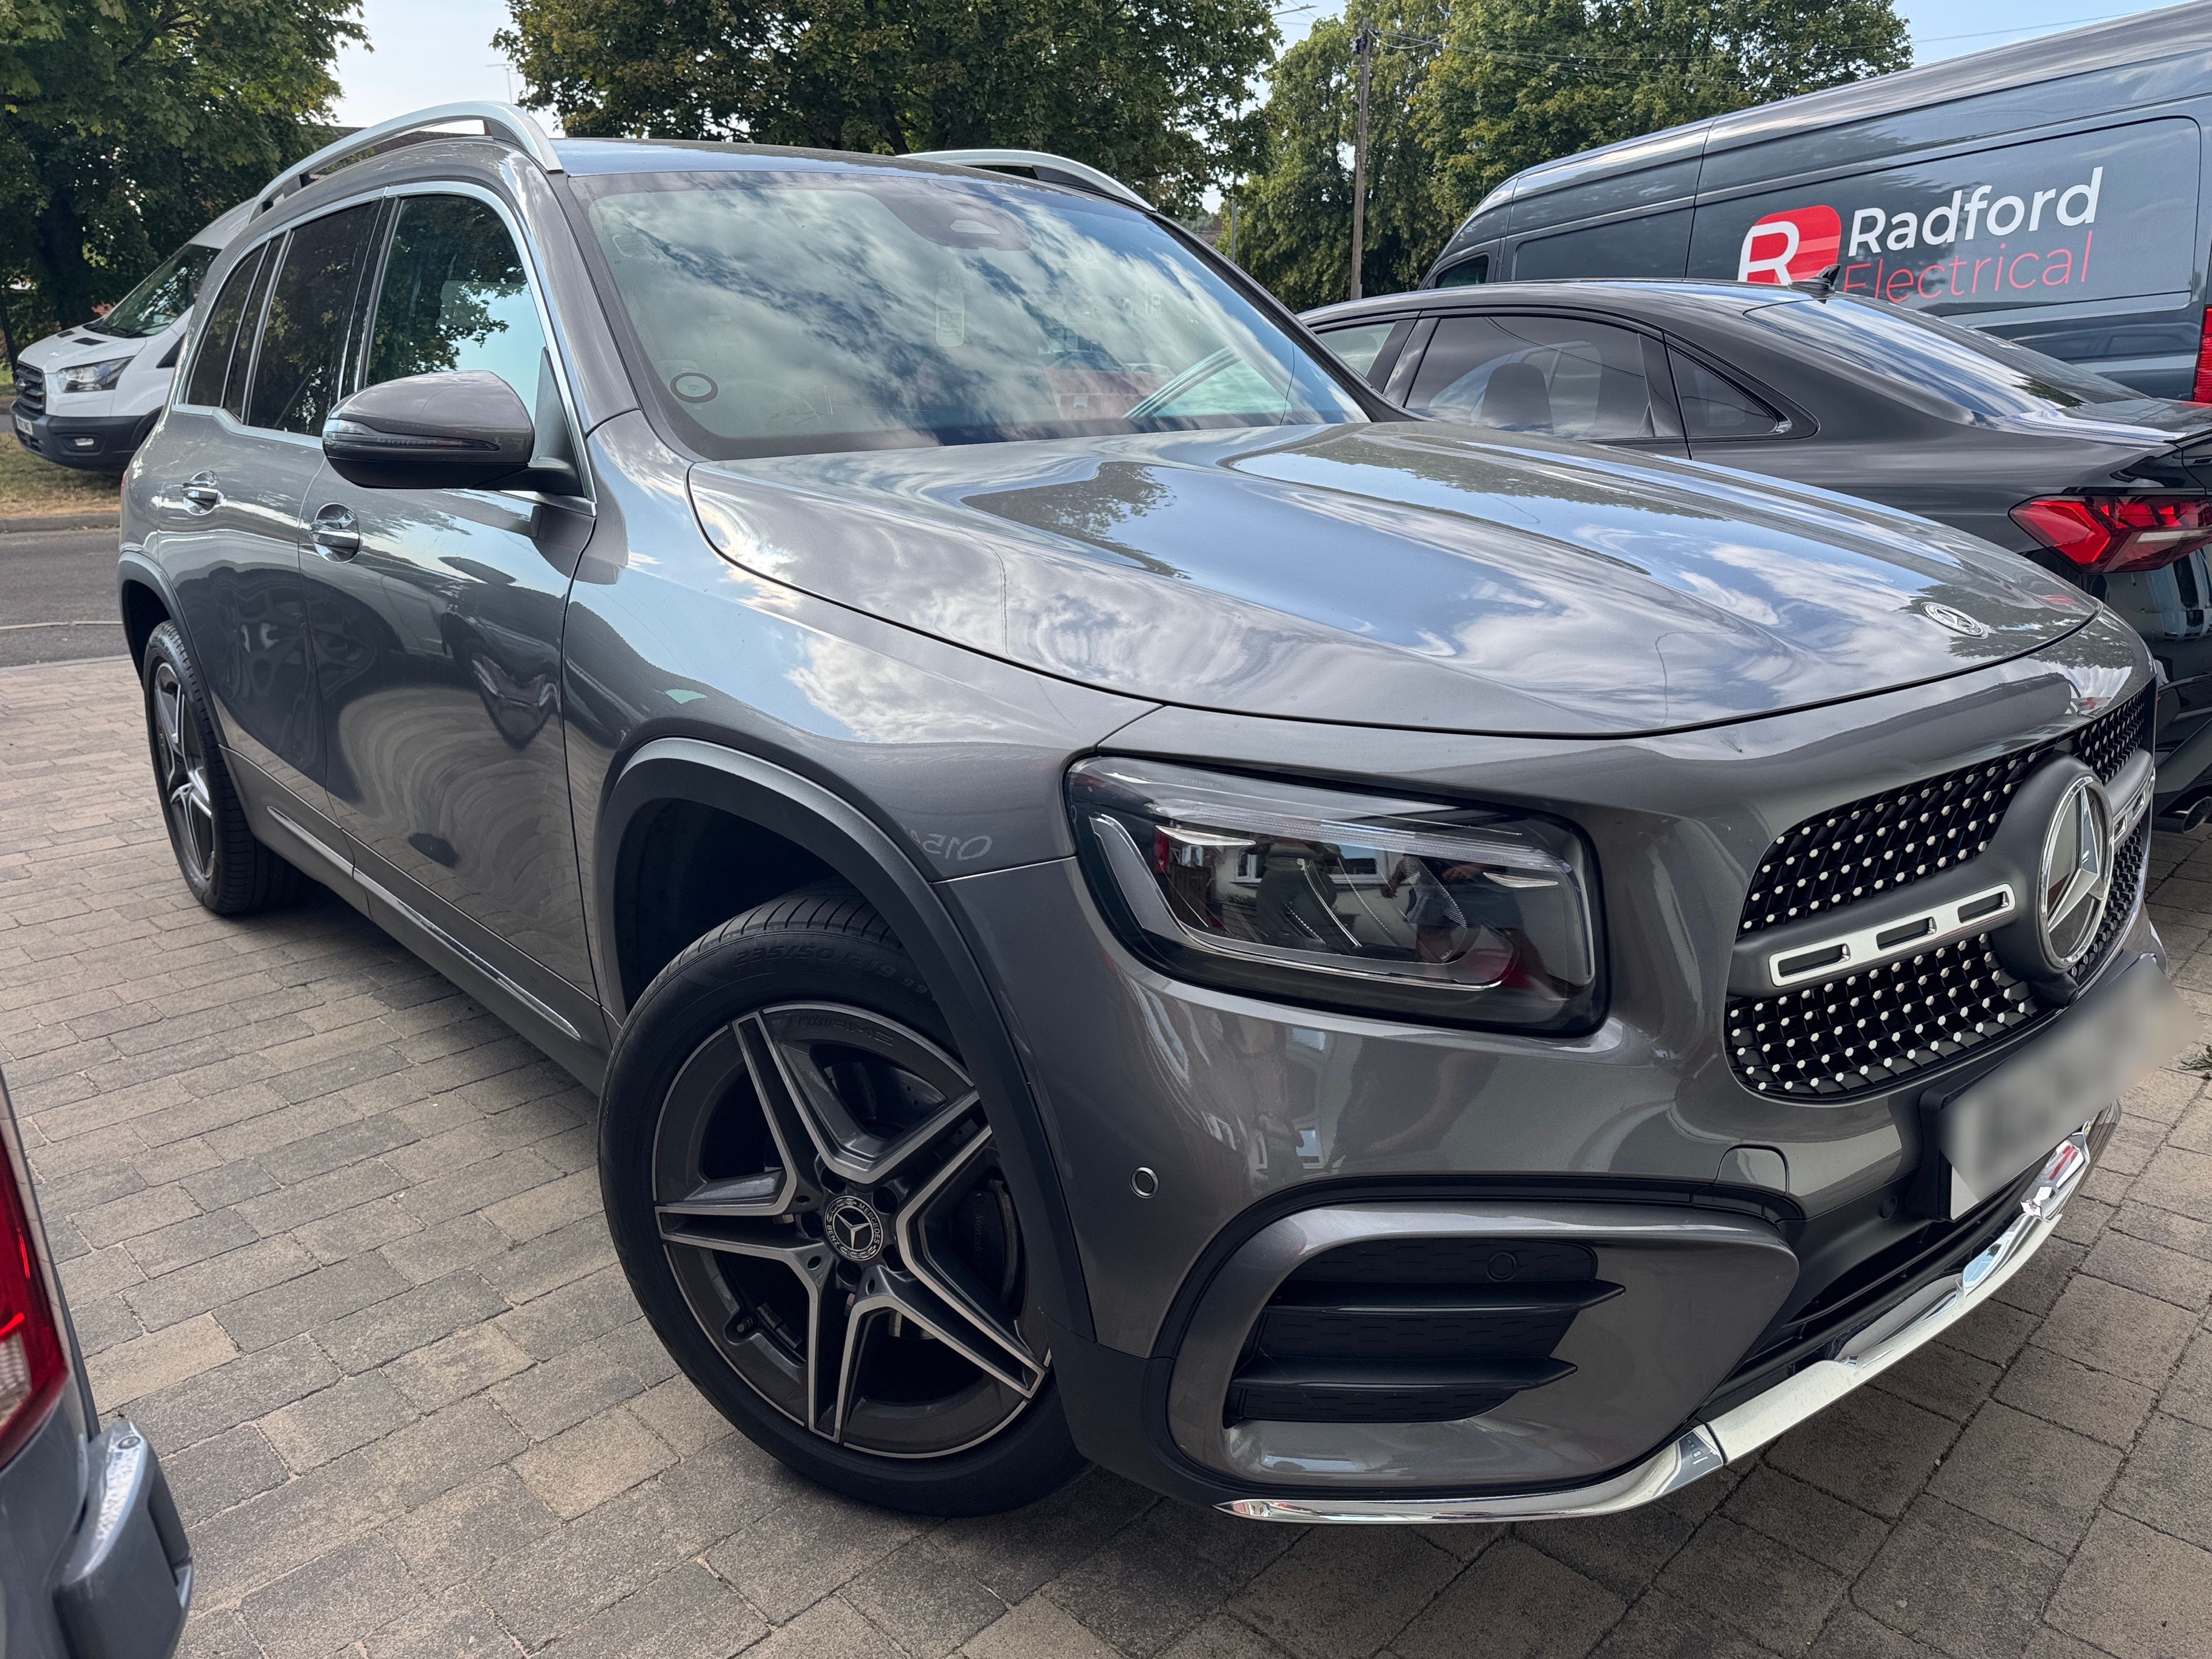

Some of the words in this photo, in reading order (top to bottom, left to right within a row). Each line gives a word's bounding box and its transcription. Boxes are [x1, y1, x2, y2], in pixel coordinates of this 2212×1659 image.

[1847, 166, 2103, 256] Radford
[1738, 221, 1800, 285] R
[1842, 230, 2093, 304] Electrical
[734, 944, 835, 967] 235/50
[826, 1224, 839, 1247] BENZ
[858, 1202, 881, 1245] MERCEDES
